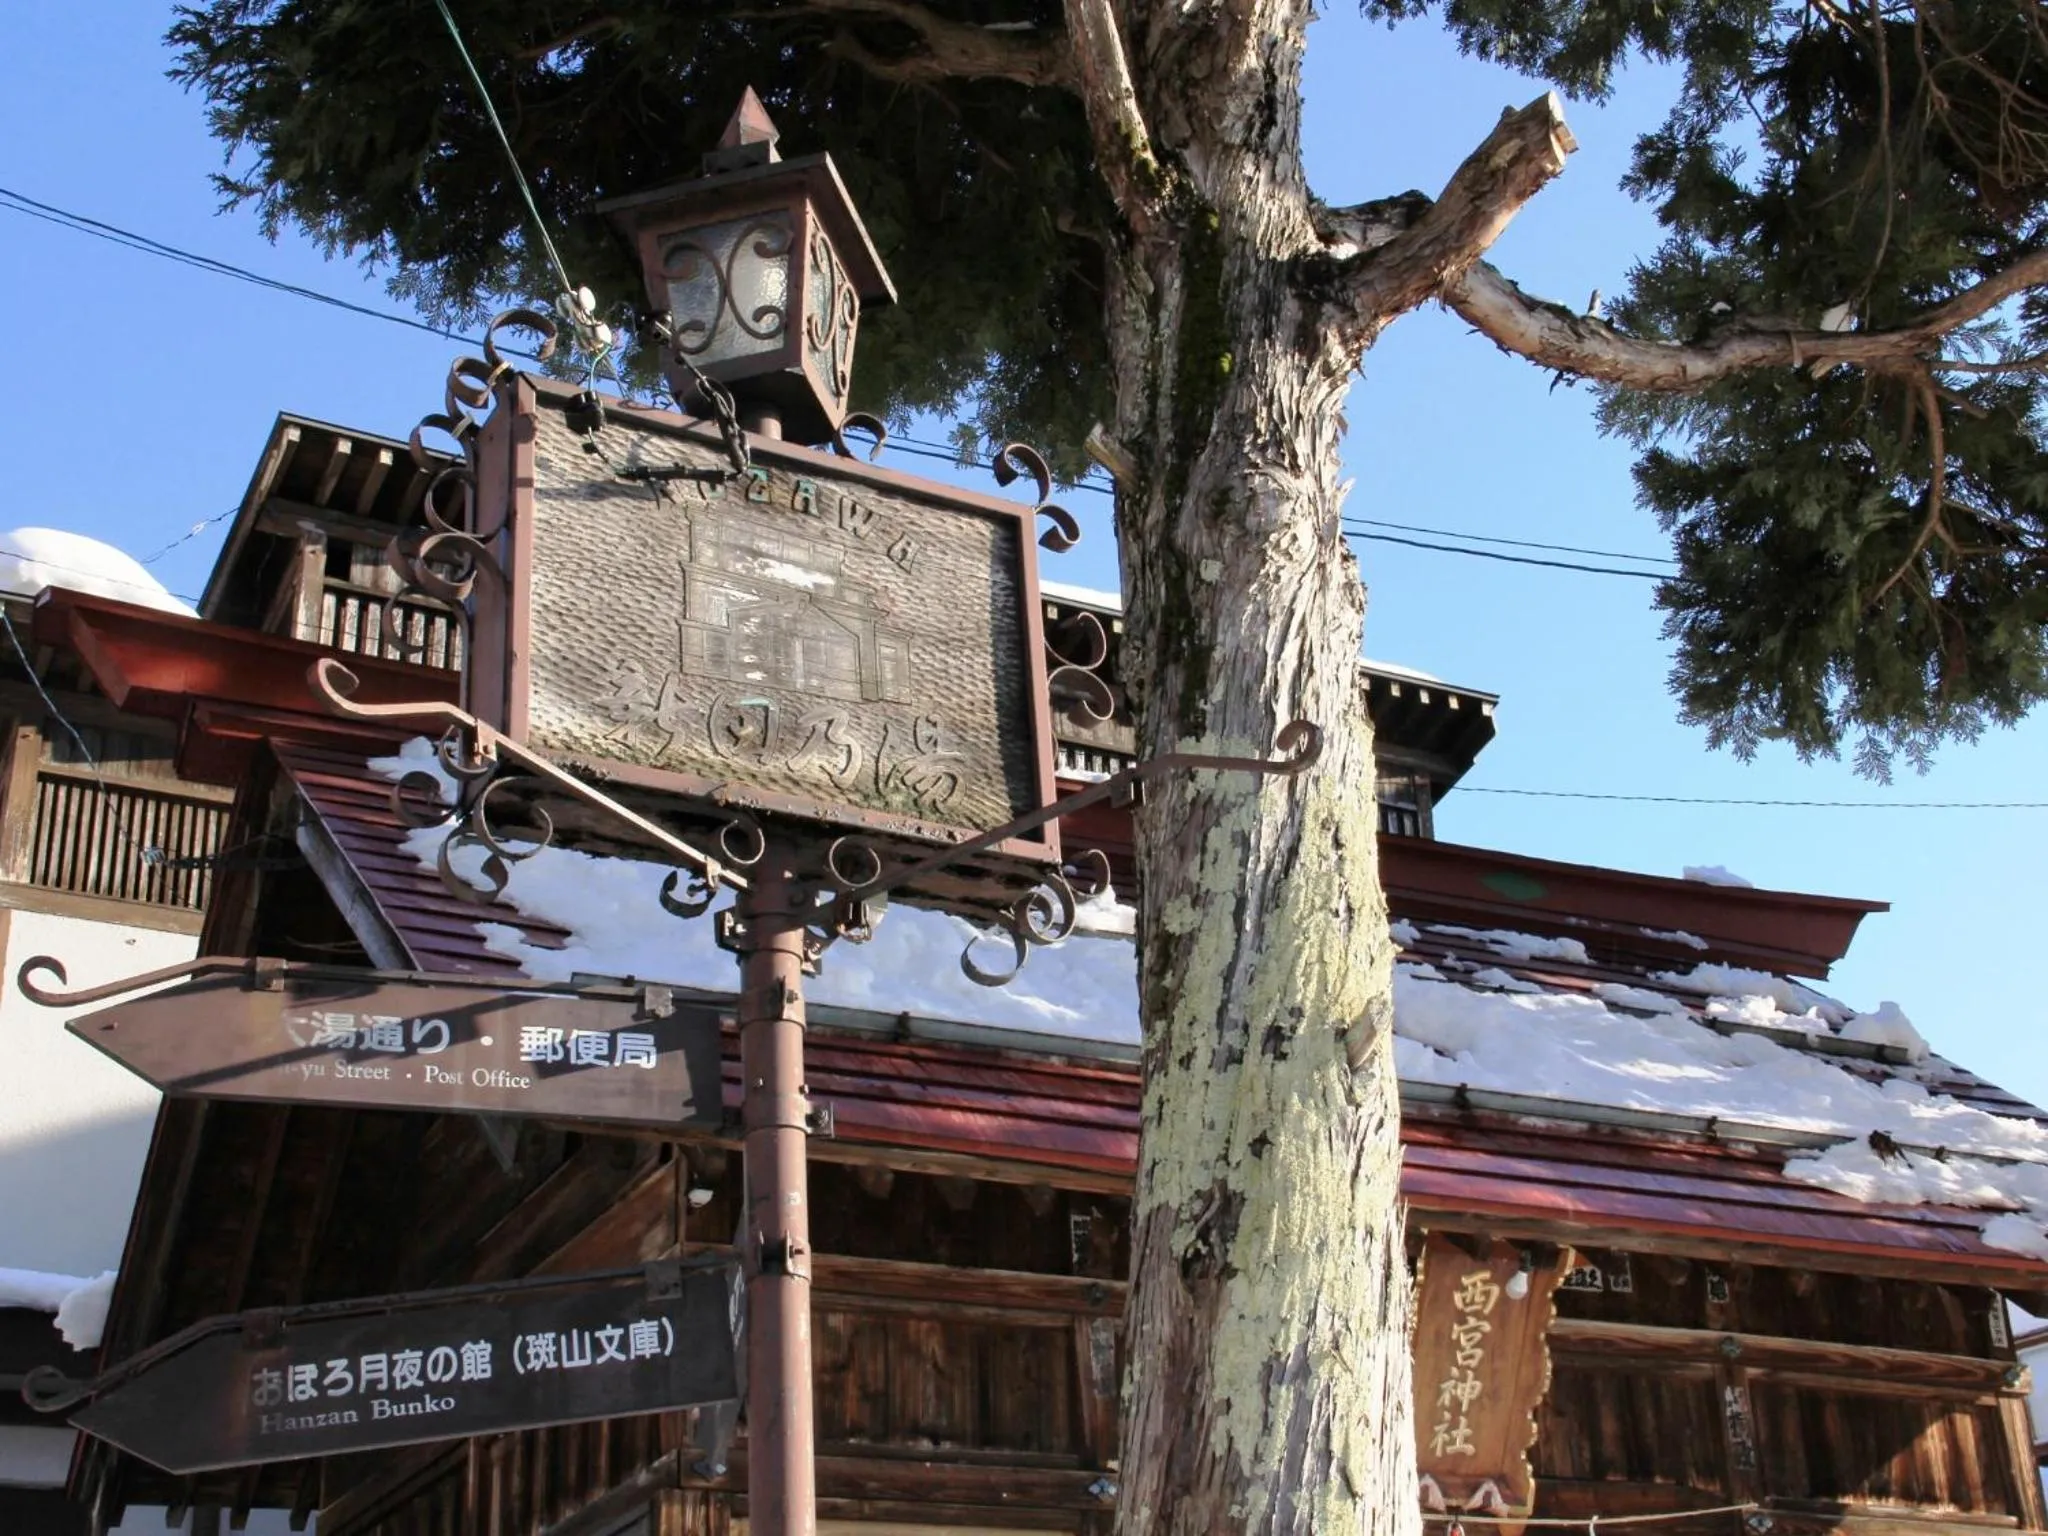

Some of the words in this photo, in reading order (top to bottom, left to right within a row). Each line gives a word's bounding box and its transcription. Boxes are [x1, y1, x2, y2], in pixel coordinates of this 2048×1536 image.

[519, 1025, 658, 1070] 郵便局
[334, 1058, 392, 1081] Street
[424, 1064, 464, 1086] Post
[472, 1067, 532, 1090] Office
[1429, 1270, 1500, 1458] 西宮神社
[260, 1408, 360, 1435] Hanzan
[370, 1393, 457, 1421] Bunko
